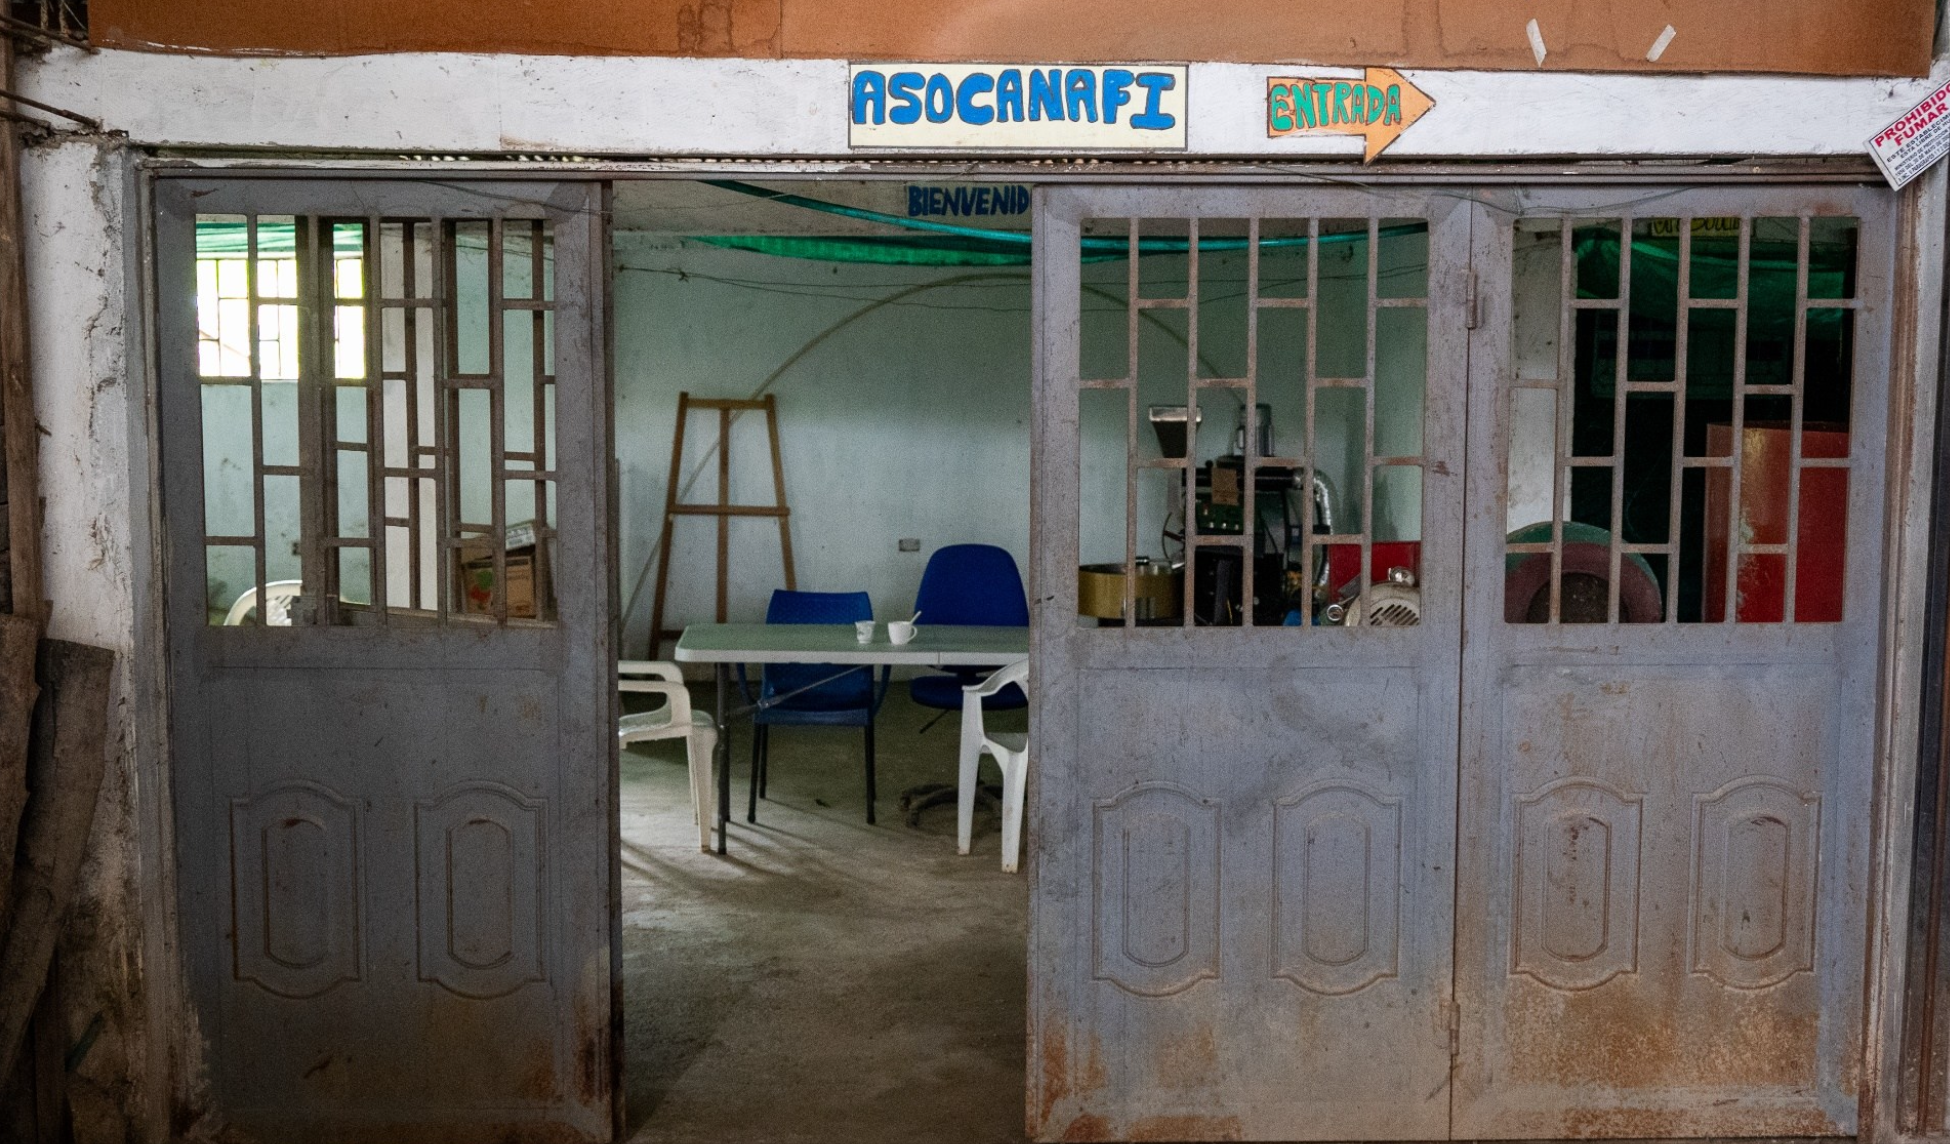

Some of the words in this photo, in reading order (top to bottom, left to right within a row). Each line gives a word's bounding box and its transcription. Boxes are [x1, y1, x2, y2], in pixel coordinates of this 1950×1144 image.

[852, 69, 1176, 130] ASOCANAFI
[1270, 82, 1402, 131] ENTRADA
[1894, 102, 1949, 146] FUMAR
[1900, 145, 1915, 158] ESTA
[1915, 132, 1932, 146] LIBRE
[1932, 125, 1941, 133] DE
[1886, 146, 1905, 163] ESTE
[908, 185, 1031, 217] BIENVENID
